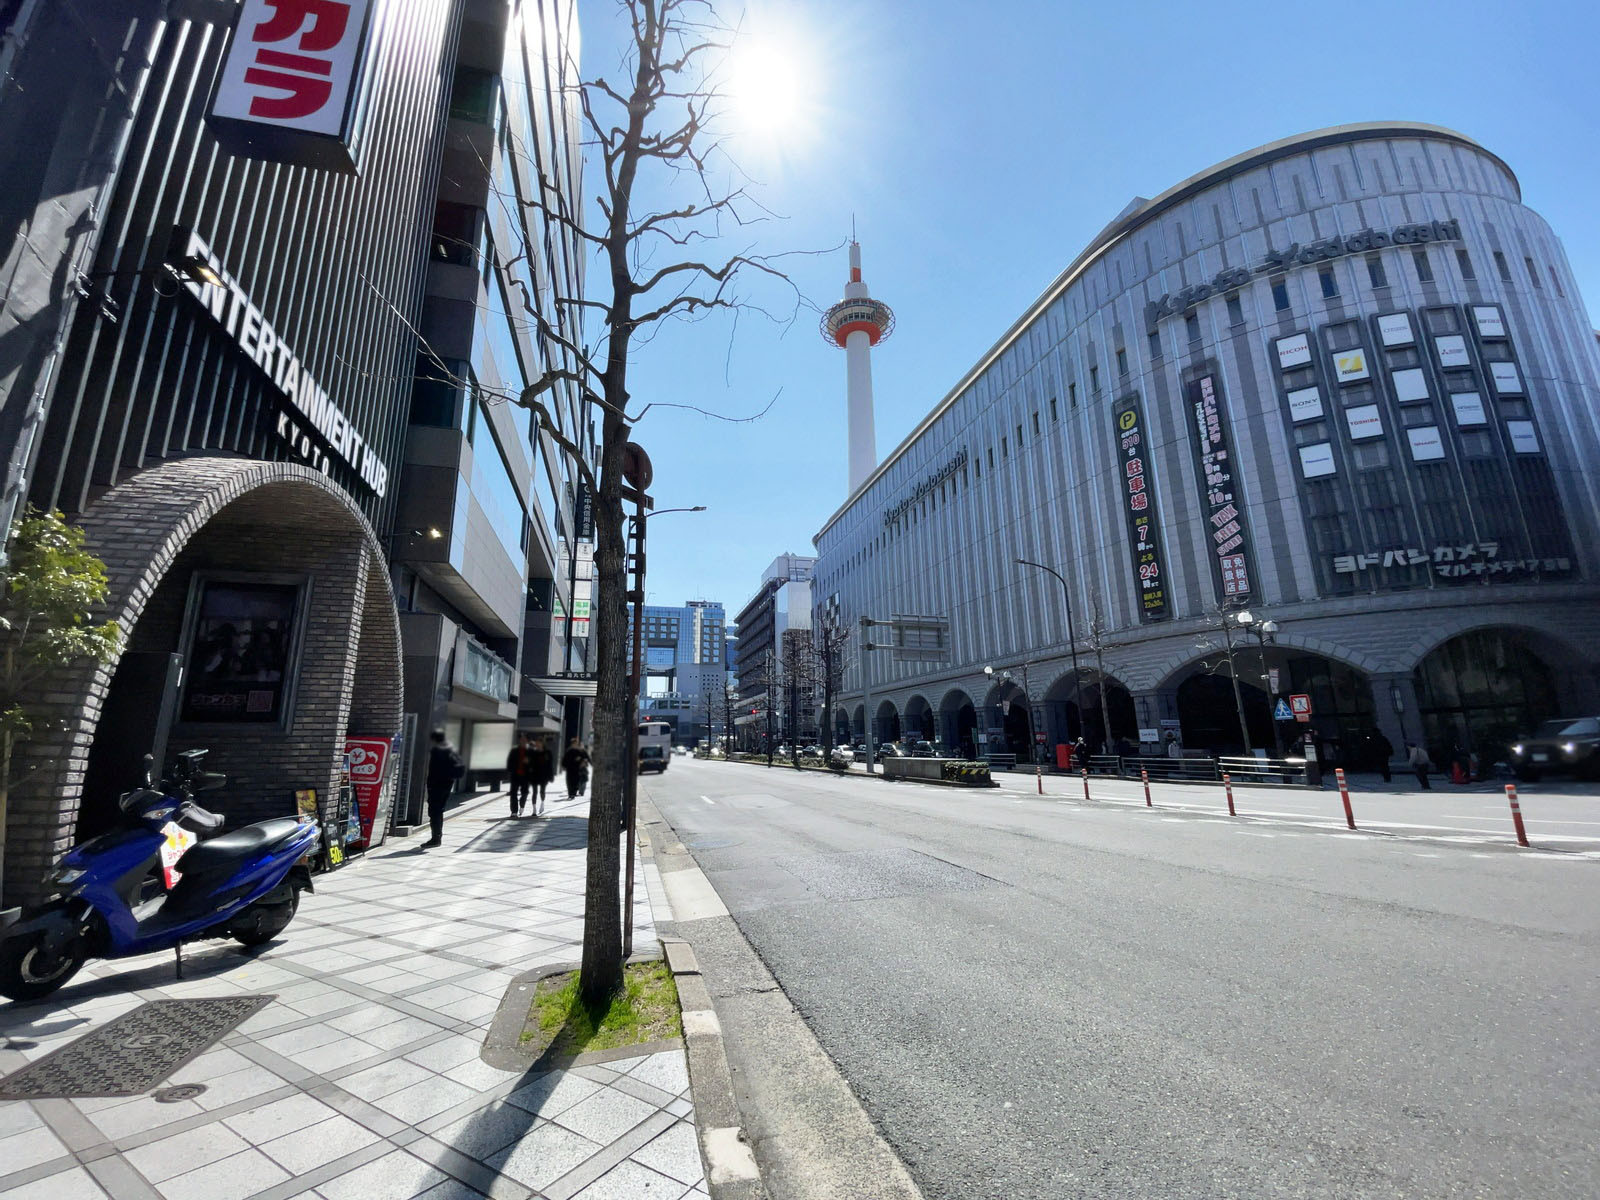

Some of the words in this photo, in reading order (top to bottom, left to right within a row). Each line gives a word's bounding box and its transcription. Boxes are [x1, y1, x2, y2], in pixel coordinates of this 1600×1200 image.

[1279, 345, 1308, 356] RICOH
[183, 230, 364, 469] ENTERTAINMENT
[360, 442, 388, 499] HUB
[1200, 376, 1221, 443] ヨドバシカメラ
[1291, 398, 1318, 408] SONY
[1350, 417, 1380, 426] TOSHIBA
[276, 410, 330, 477] KYOTO
[1126, 458, 1148, 511] 駐車場
[1210, 503, 1239, 528] TAX
[1213, 519, 1241, 544] FREE
[1216, 534, 1243, 556] STORE
[1334, 542, 1498, 573] ヨドバシカメラ
[1140, 562, 1158, 580] 24
[1234, 557, 1248, 591] 免税品
